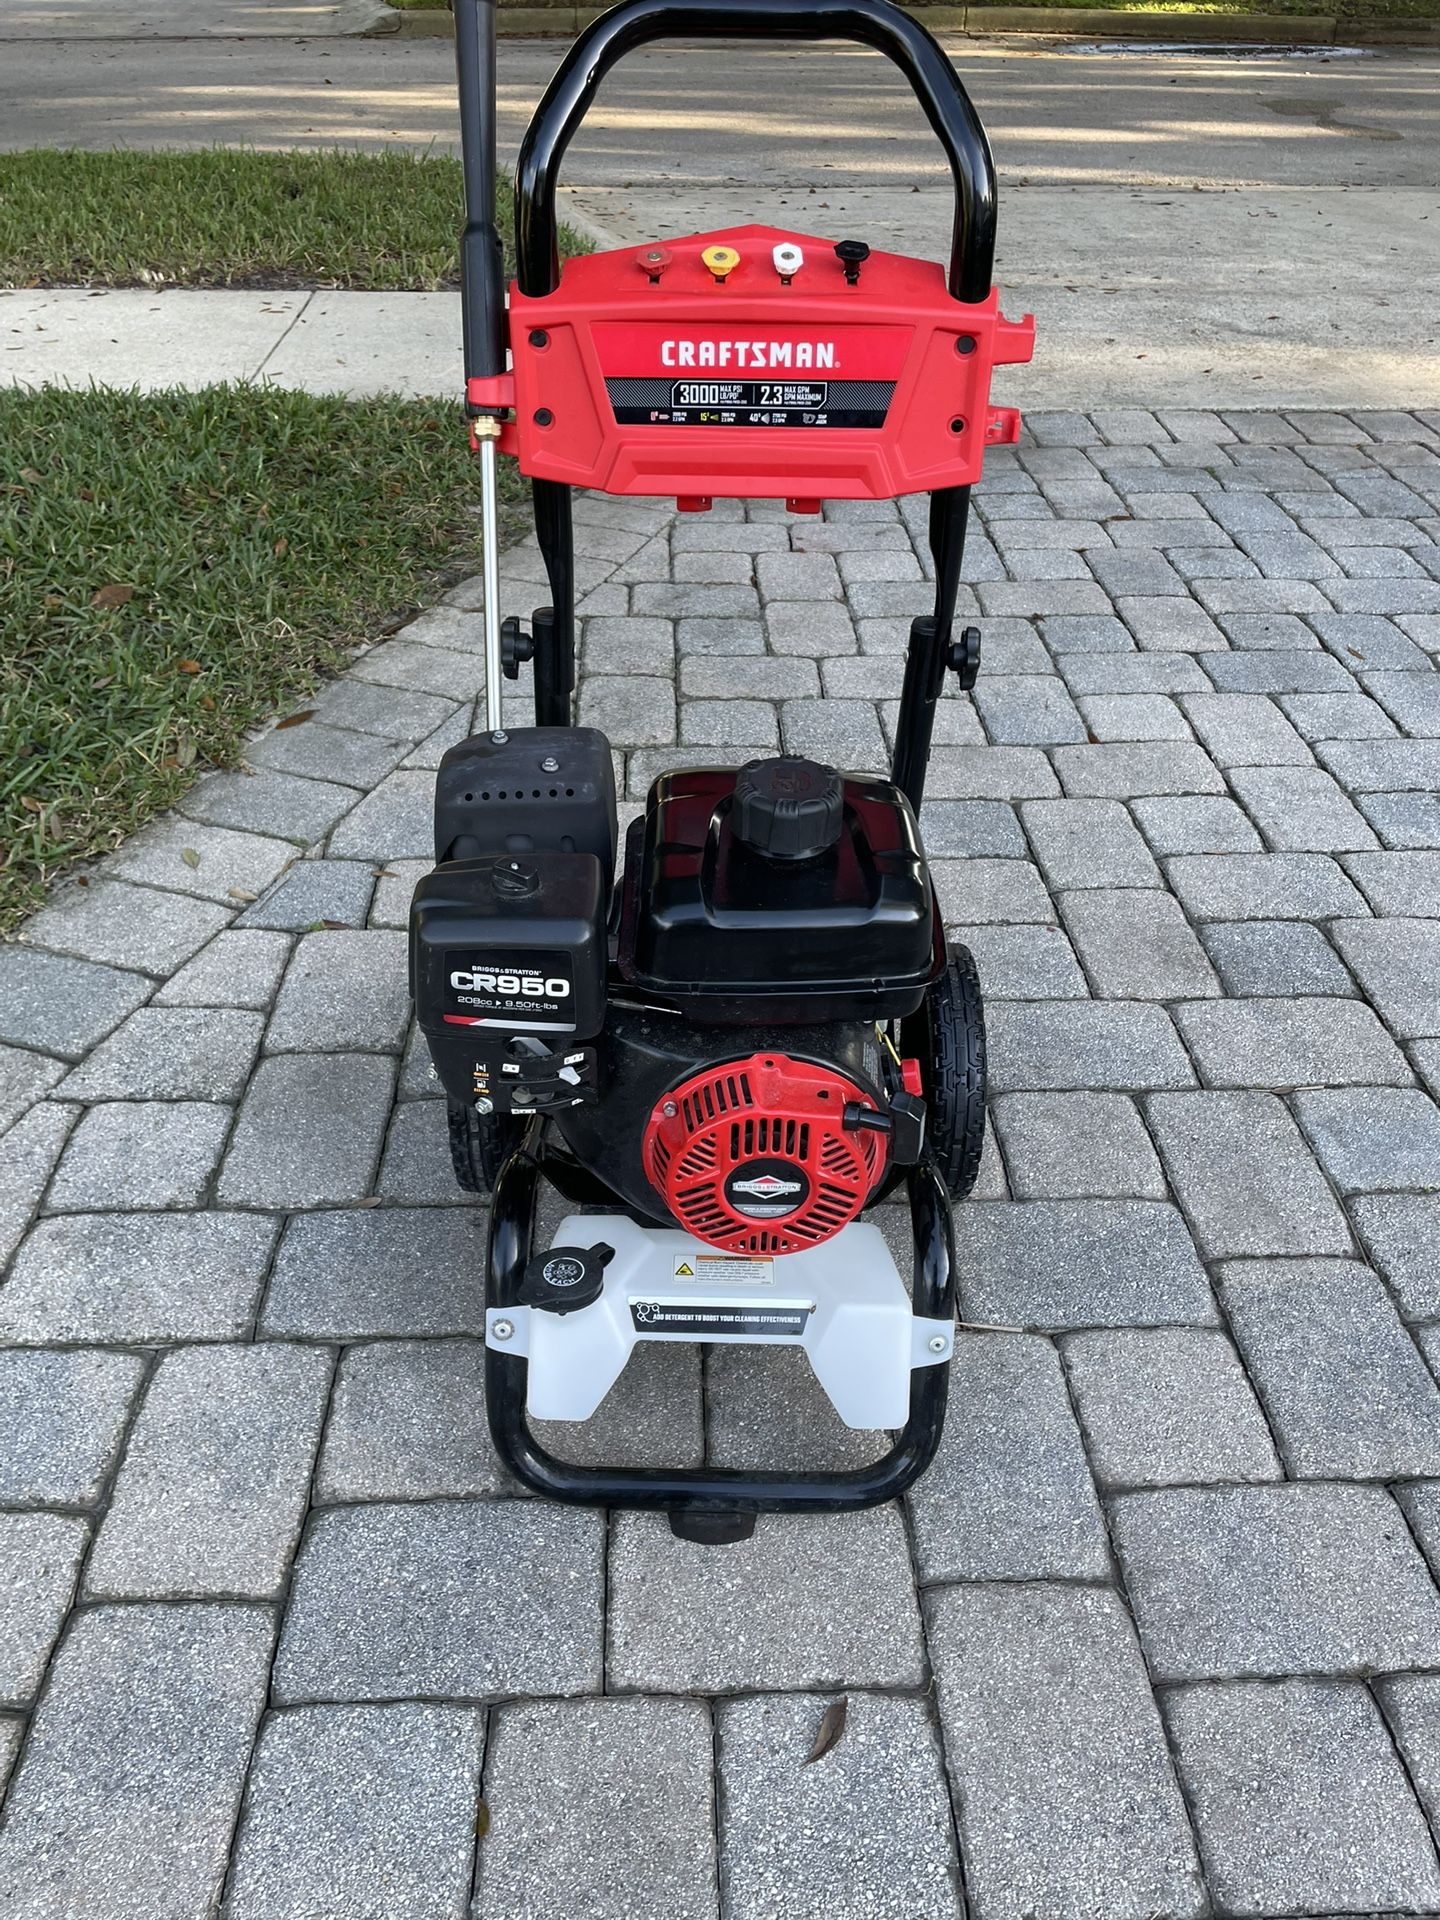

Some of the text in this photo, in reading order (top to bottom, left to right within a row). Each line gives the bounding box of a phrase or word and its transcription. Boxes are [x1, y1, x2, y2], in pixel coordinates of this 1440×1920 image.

[661, 341, 834, 368] CRAFTSMAN
[680, 384, 719, 404] 3000
[760, 386, 783, 405] 2.3
[797, 393, 822, 401] MAXIMUM
[450, 971, 570, 998] CR950
[457, 995, 493, 1006] 208cc
[505, 1000, 559, 1010] 9.50ft-lbs
[703, 1314, 719, 1322] BOOST
[735, 1315, 760, 1323] CLEANING
[761, 1316, 801, 1324] EFFECTIVENESS
